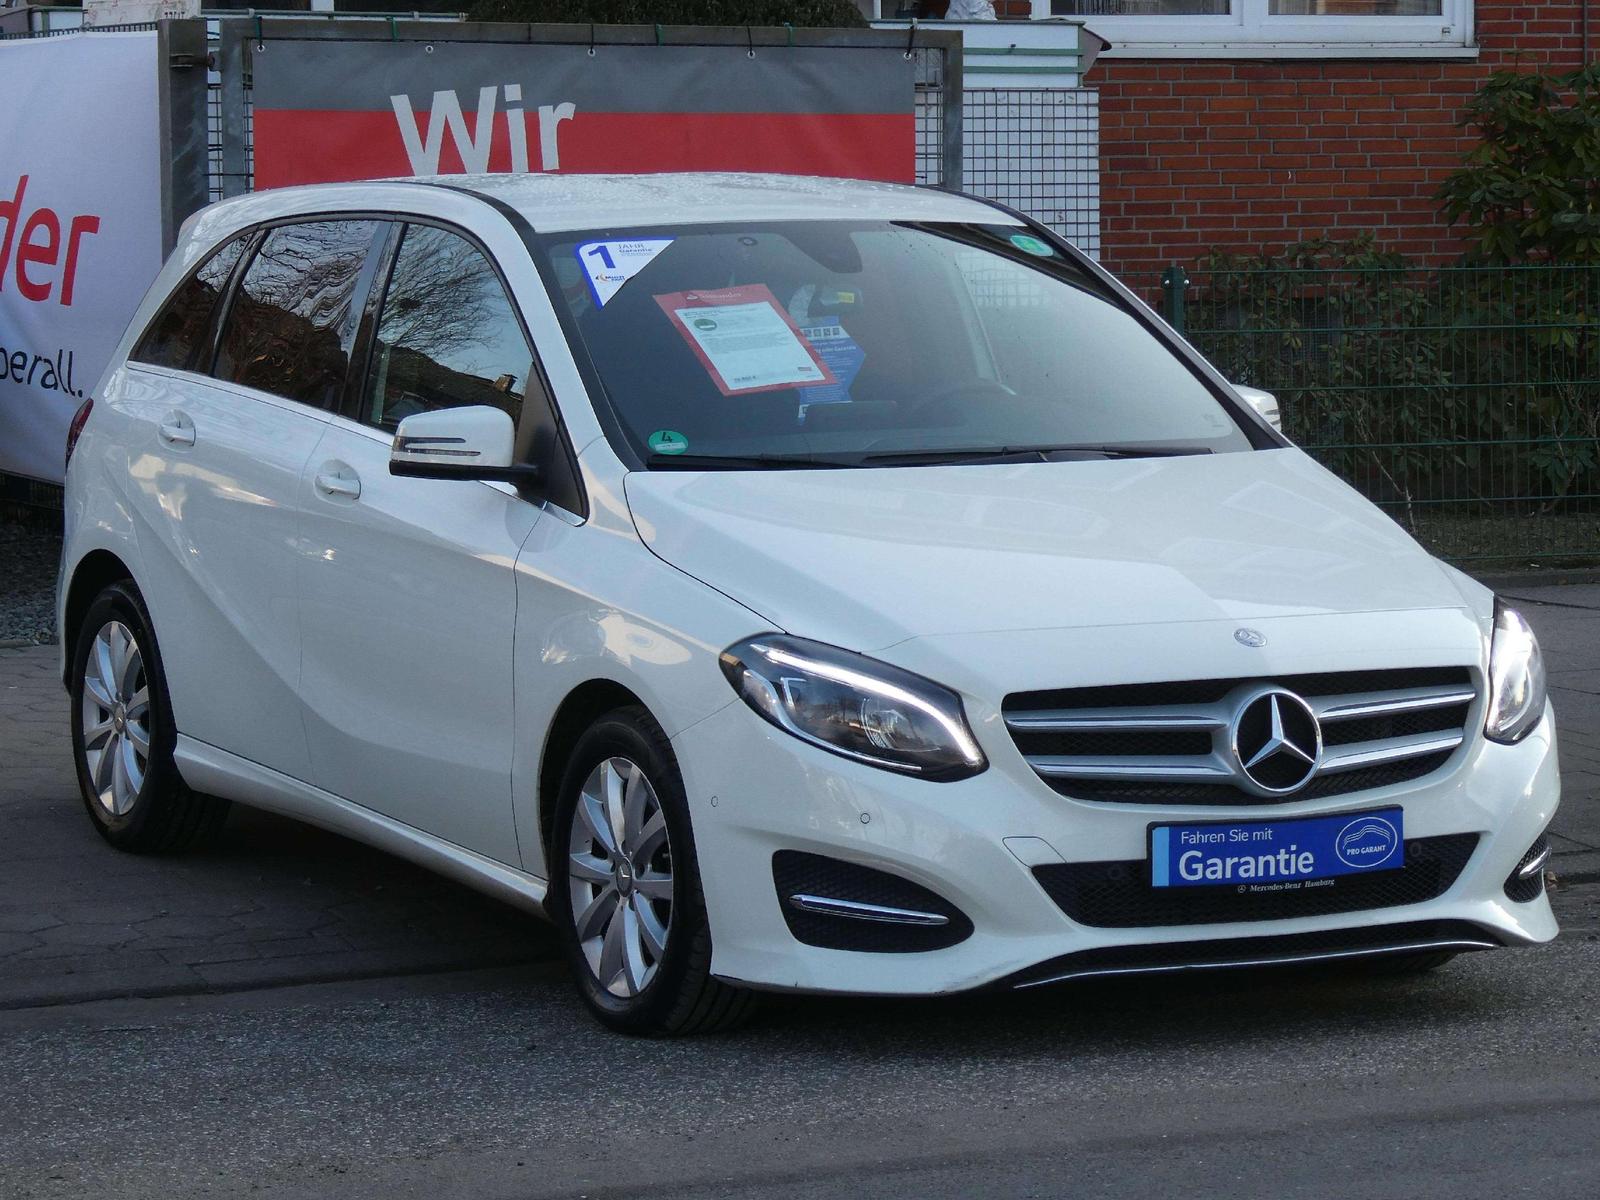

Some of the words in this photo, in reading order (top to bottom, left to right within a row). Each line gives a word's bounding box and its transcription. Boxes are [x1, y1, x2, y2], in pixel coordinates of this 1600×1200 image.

[390, 84, 577, 177] Wir
[587, 245, 616, 269] 1
[661, 431, 673, 443] 4
[1180, 830, 1226, 845] Fahren
[1228, 828, 1249, 842] Sie
[1252, 827, 1273, 841] mit
[1346, 847, 1360, 856] PRO
[1360, 844, 1387, 855] GARANT
[1178, 844, 1315, 881] Garantie
[1249, 882, 1303, 893] Mercedes-Benz
[1304, 878, 1335, 889] Hamburg
